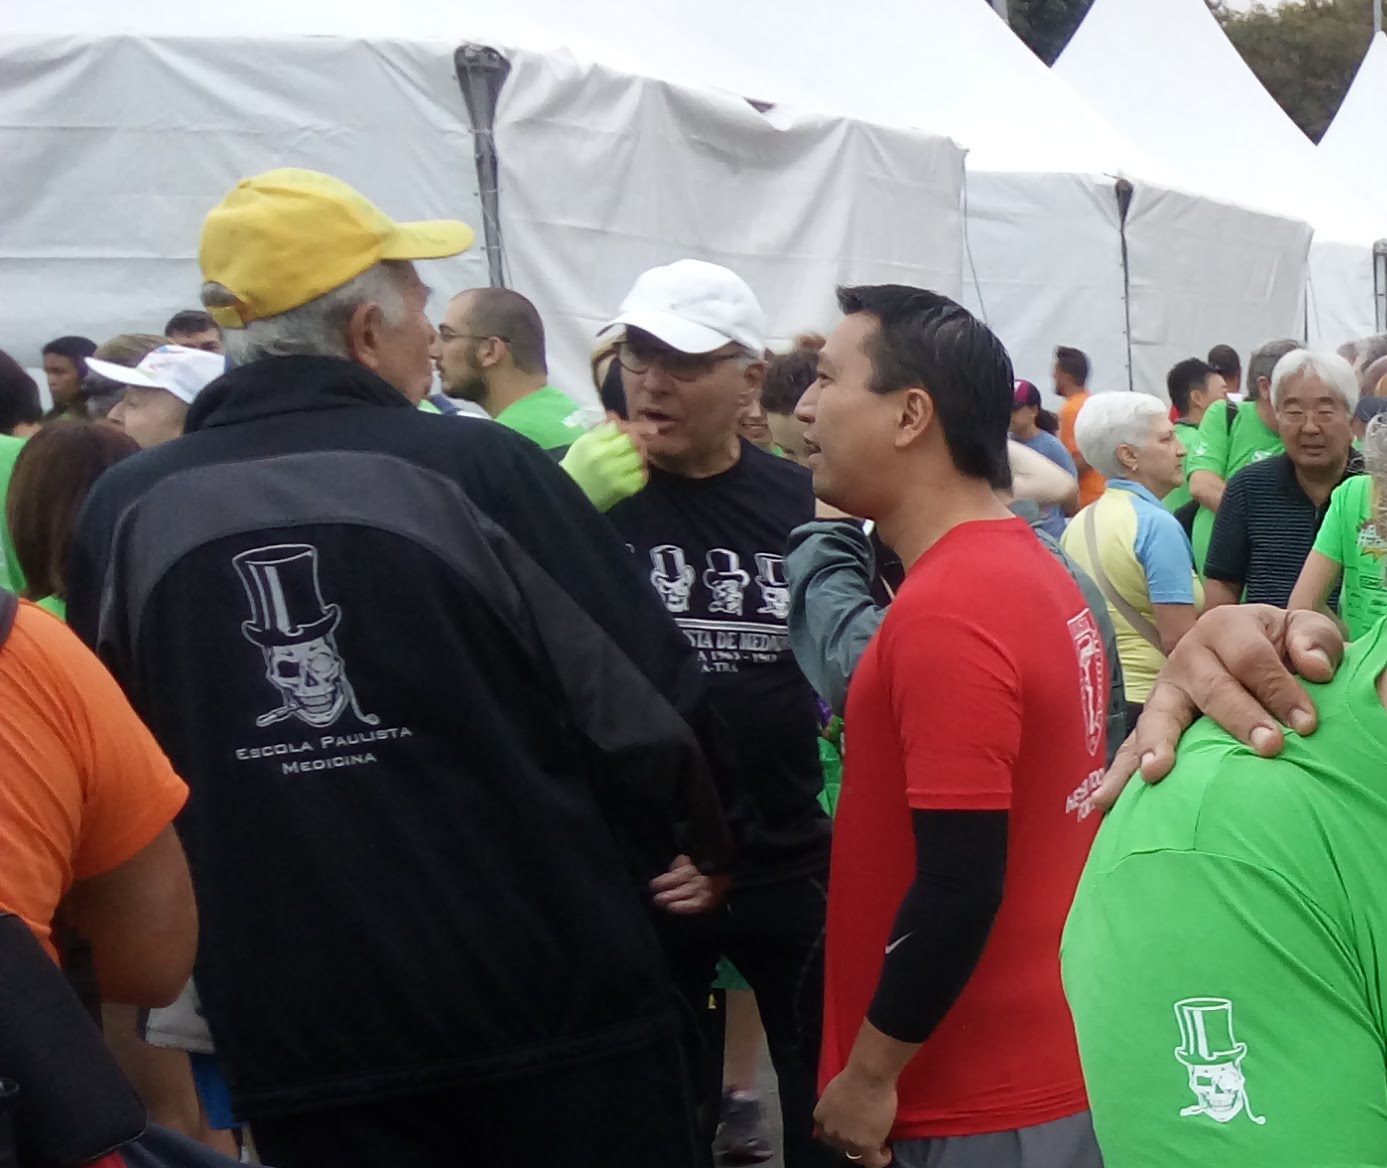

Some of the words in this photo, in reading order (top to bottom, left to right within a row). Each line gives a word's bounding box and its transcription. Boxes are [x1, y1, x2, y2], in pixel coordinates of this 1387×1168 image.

[234, 740, 315, 761] ESCOLA
[319, 726, 413, 750] PAULISTA
[281, 752, 378, 776] MEDICINA
